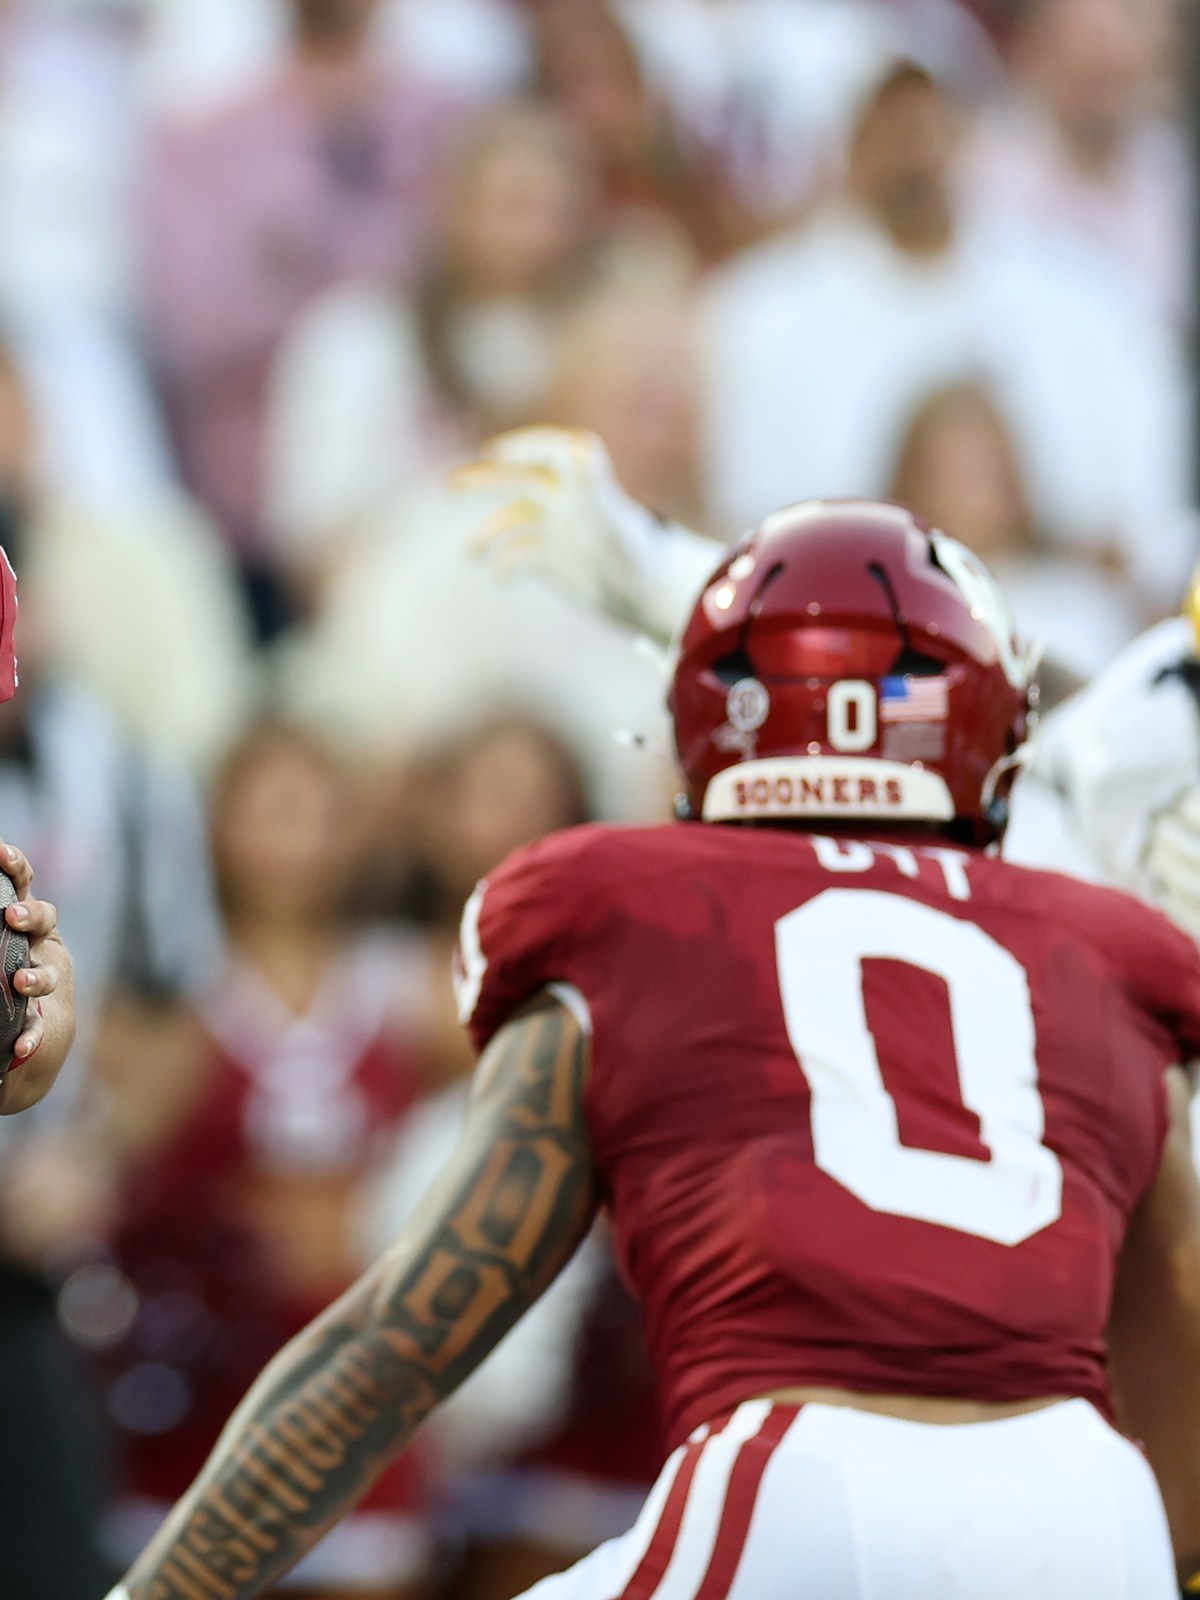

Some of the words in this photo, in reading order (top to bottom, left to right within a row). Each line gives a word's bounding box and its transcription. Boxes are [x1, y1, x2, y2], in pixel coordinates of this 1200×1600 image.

[827, 679, 876, 752] 0
[734, 775, 902, 806] SOONERS
[775, 886, 1063, 1246] 0
